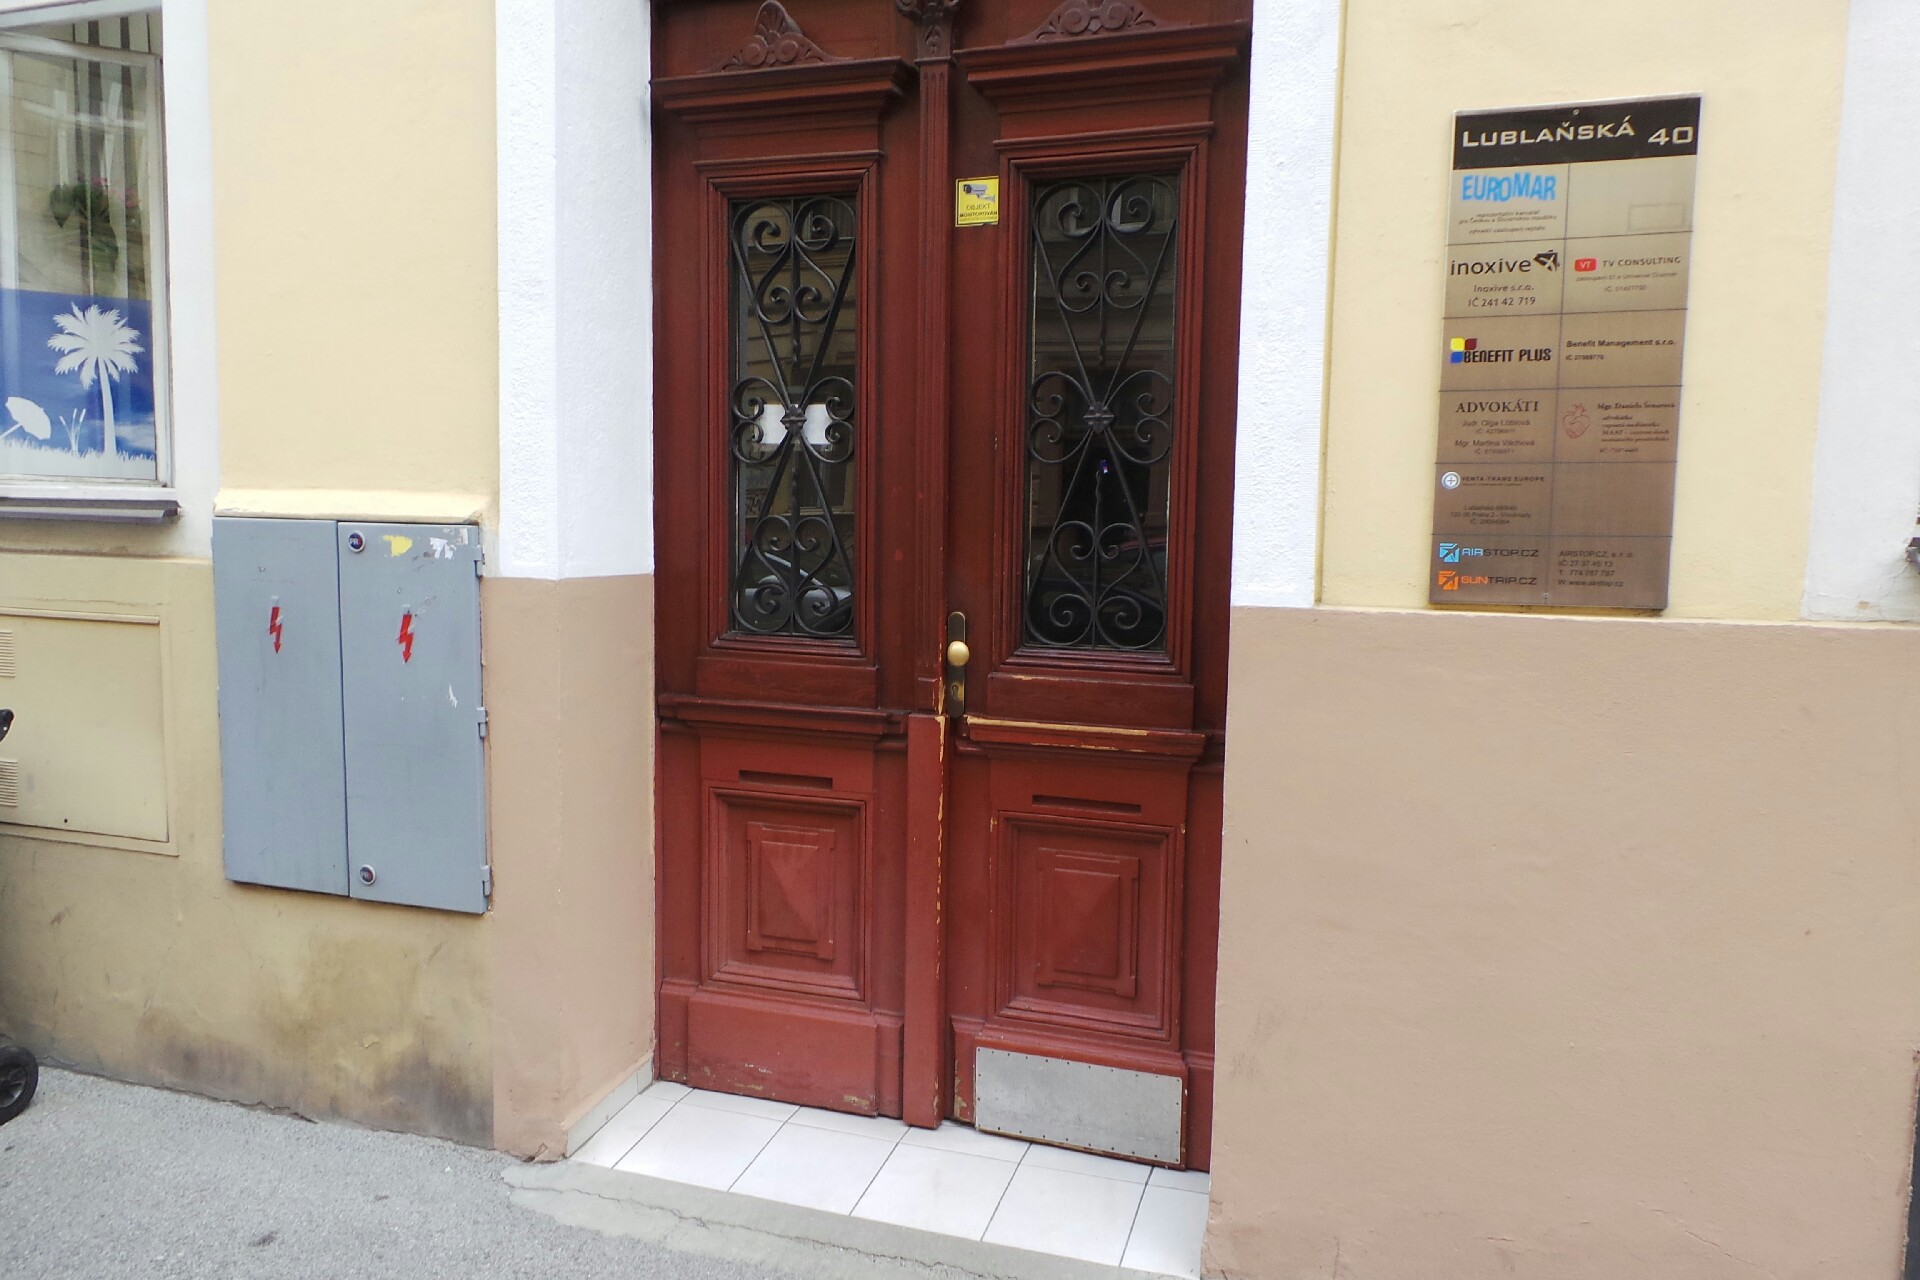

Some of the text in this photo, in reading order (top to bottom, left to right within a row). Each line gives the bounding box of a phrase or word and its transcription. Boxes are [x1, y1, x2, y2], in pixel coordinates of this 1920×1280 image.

[1462, 115, 1694, 148] LUBLAŇSKÁ 40
[1461, 172, 1557, 202] EUROMAR
[1450, 258, 1532, 276] inoxive
[1602, 256, 1682, 268] TV CONSULTING
[1473, 284, 1508, 293] Inoxive
[1481, 297, 1499, 307] 241
[1501, 297, 1514, 306] 42
[1518, 296, 1536, 306] 719
[1566, 340, 1596, 348] Benefit
[1597, 339, 1653, 348] Management
[1464, 348, 1552, 363] BENEFIT PLUS
[1455, 399, 1540, 413] ADVOKÁTI
[1461, 548, 1539, 558] AIRSTOP.CZ
[1460, 575, 1537, 586] SUNTRIP.CZ
